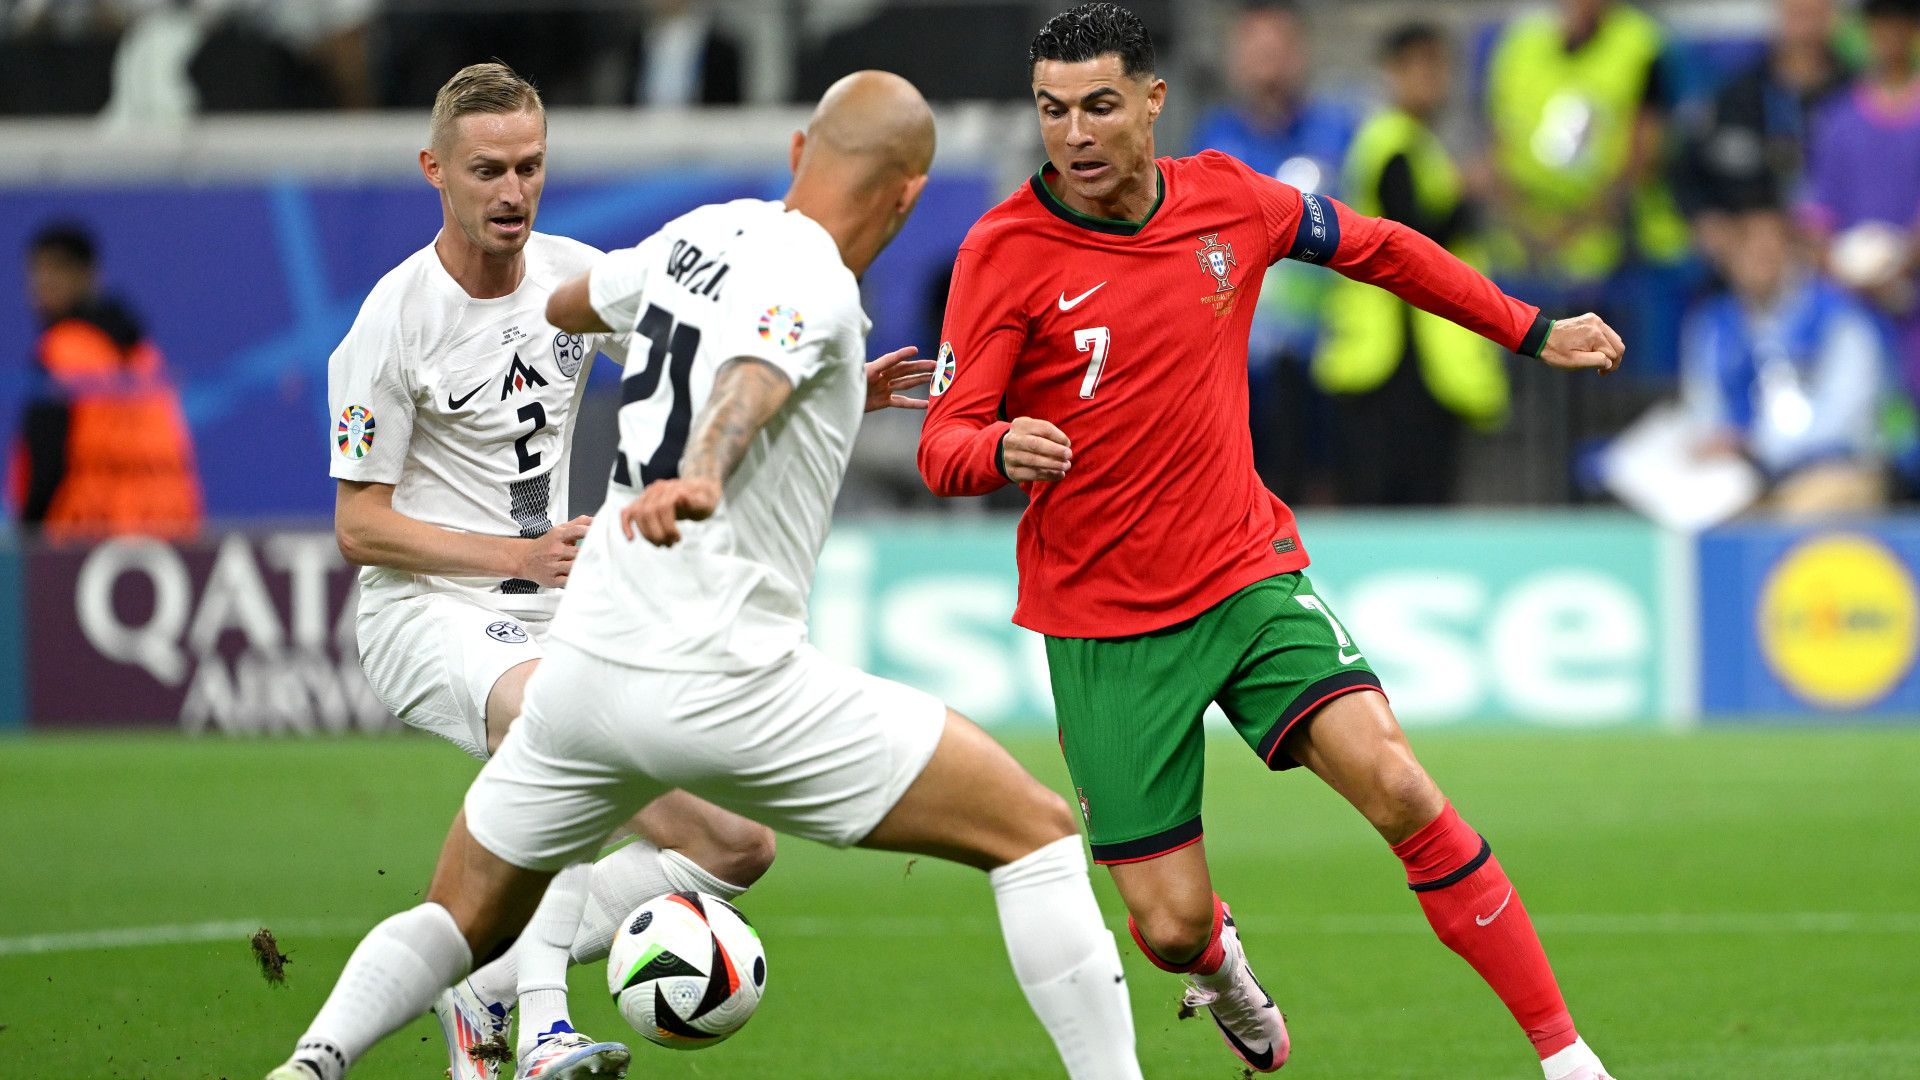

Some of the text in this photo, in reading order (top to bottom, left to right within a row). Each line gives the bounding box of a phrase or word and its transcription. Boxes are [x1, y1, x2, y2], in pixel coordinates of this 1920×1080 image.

[613, 302, 701, 488] 21
[1073, 326, 1111, 399] 7
[514, 401, 547, 475] 2
[75, 533, 360, 687] QAT
[1293, 594, 1351, 648] 7
